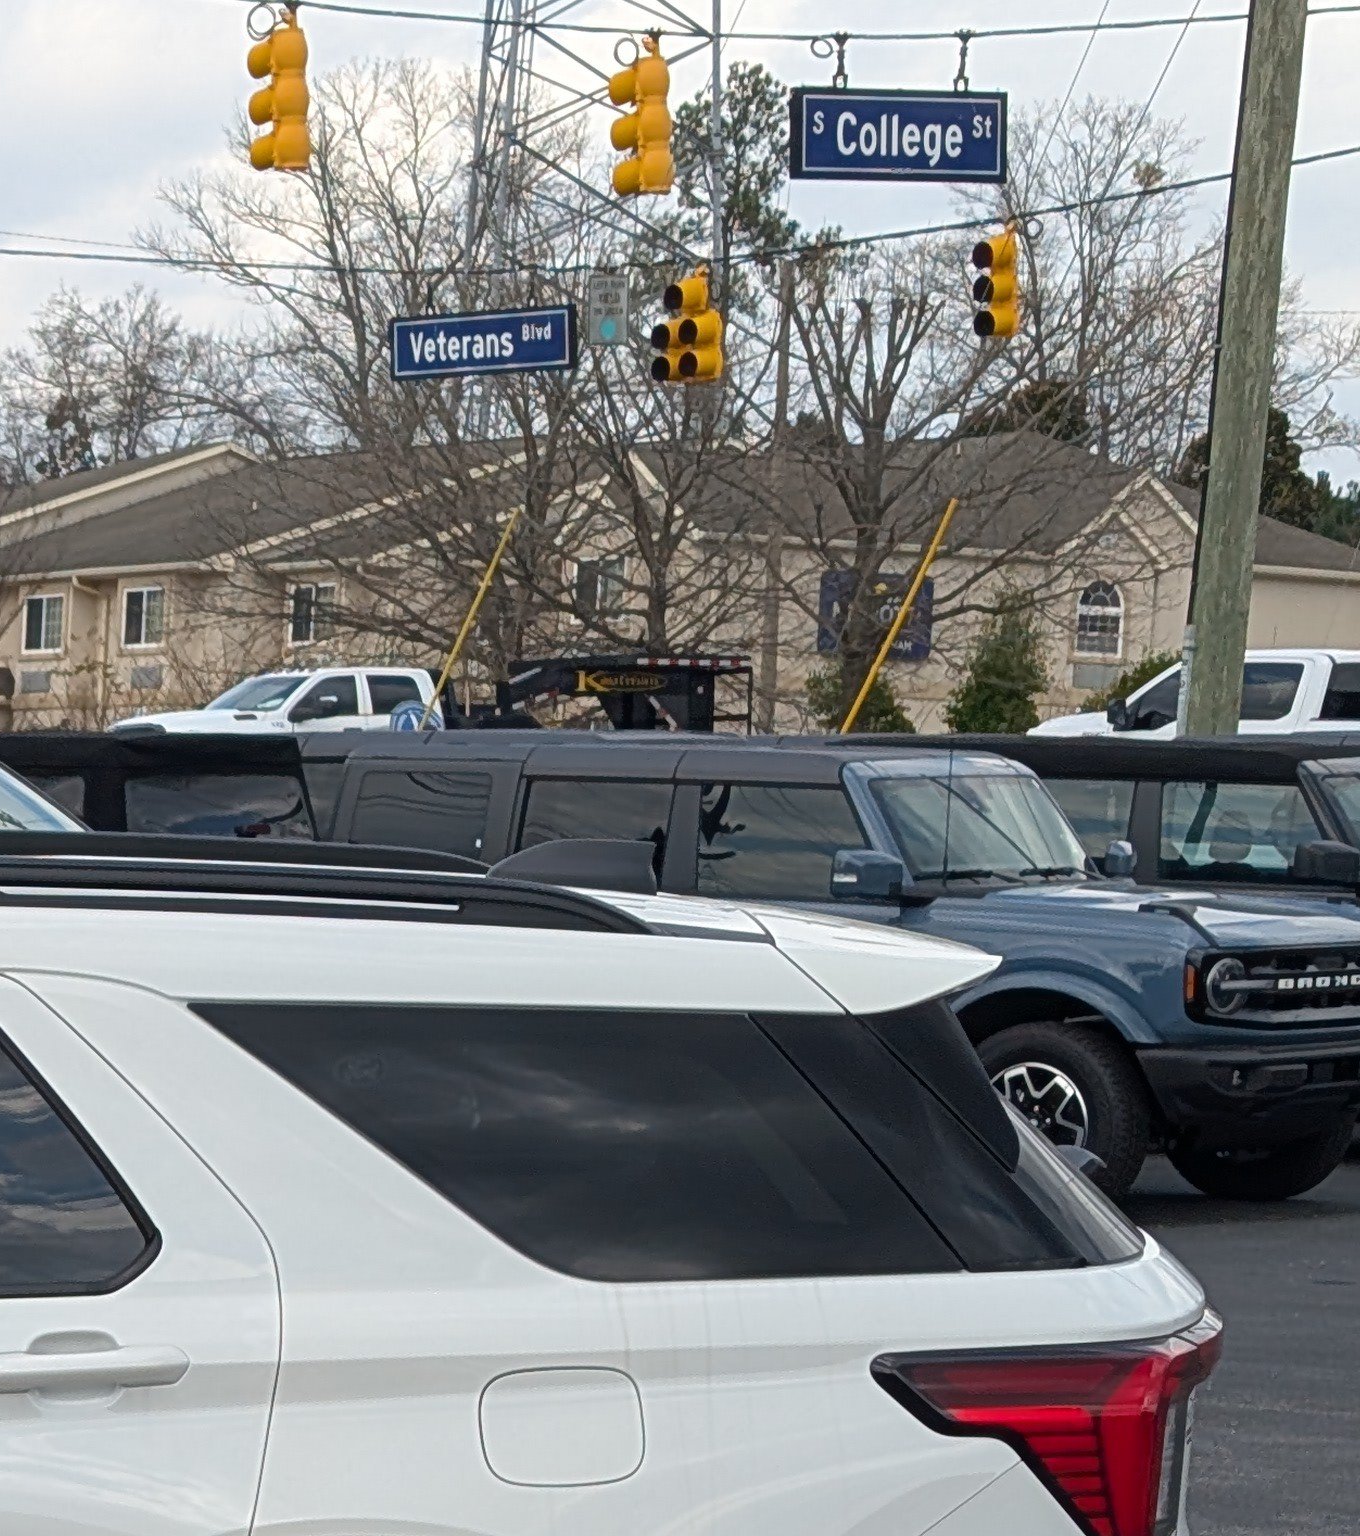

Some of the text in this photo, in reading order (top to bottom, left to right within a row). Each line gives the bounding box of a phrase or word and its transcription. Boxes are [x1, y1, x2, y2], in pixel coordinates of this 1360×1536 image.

[812, 110, 993, 168] S College St
[409, 322, 552, 364] Veterans Blvd
